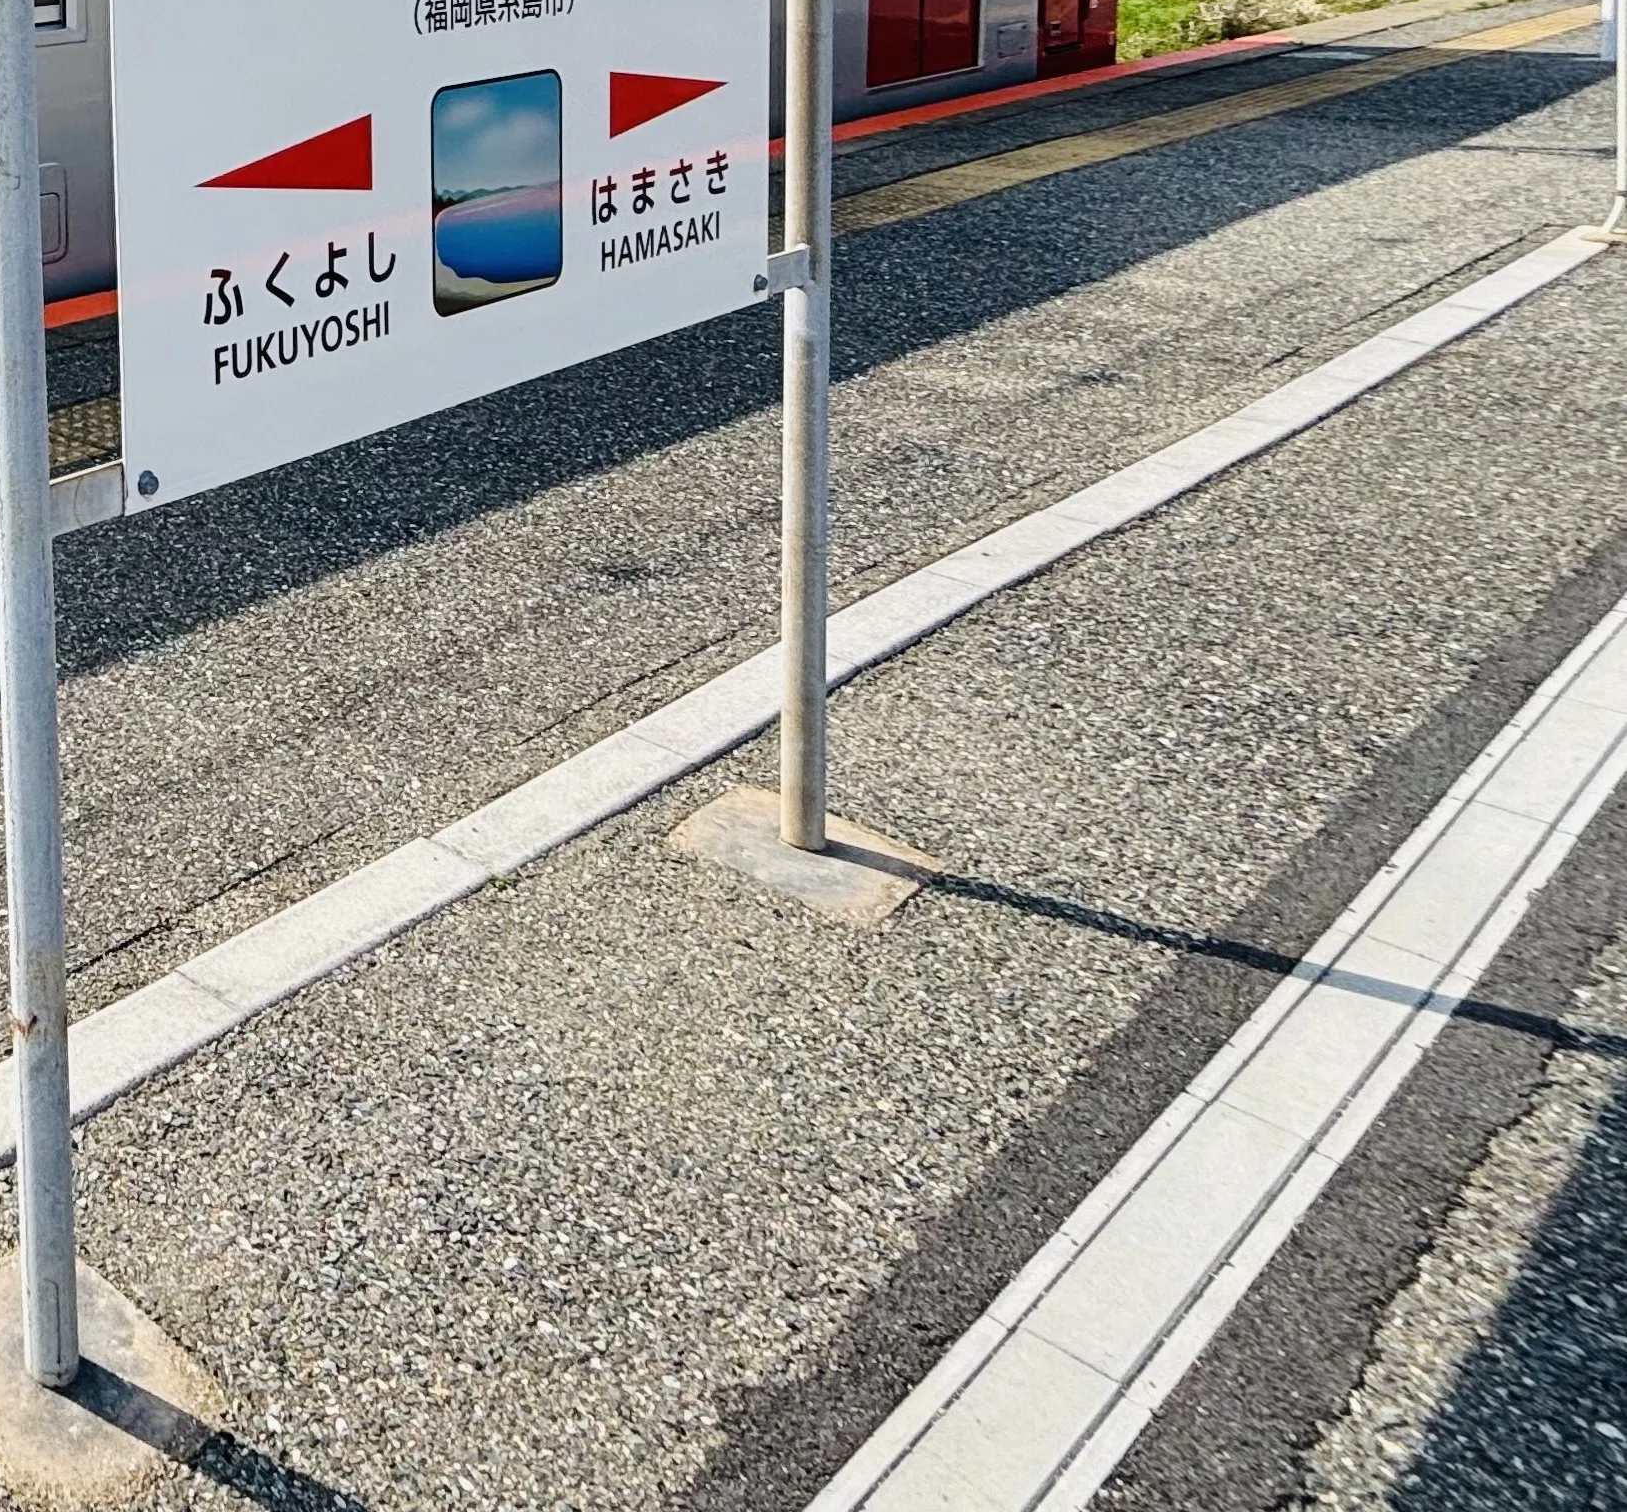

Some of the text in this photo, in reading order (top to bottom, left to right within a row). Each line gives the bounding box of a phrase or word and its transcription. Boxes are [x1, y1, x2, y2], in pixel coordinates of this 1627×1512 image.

[591, 150, 729, 226] はまさき
[202, 231, 397, 327] ふくよし
[600, 210, 721, 272] HAMASAKI
[214, 300, 391, 386] FUKUYOSHI
